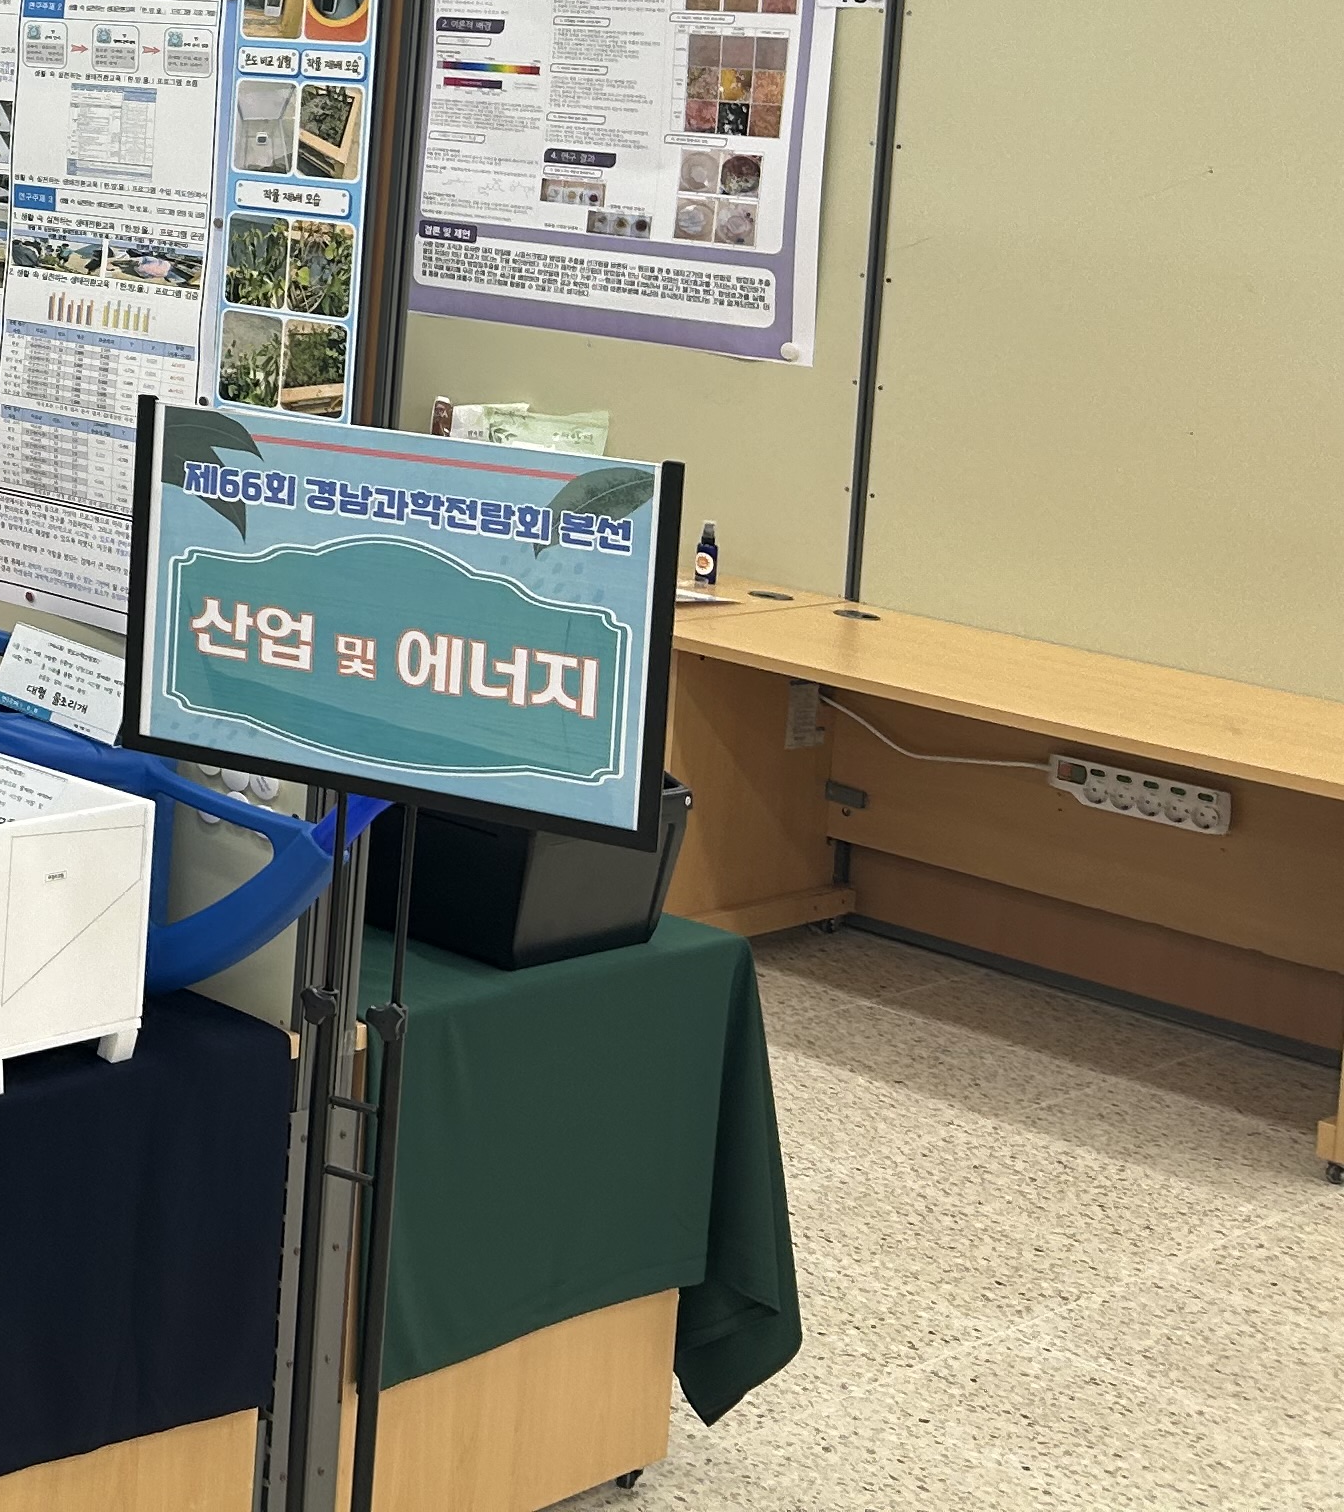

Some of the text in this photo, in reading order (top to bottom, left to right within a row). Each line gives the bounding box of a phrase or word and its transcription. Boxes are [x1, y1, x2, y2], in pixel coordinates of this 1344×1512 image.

[183, 463, 632, 552] 제66회 경남과학전람회 본선
[191, 597, 314, 671] 산업
[335, 634, 376, 679] 및
[397, 628, 598, 719] 에너지
